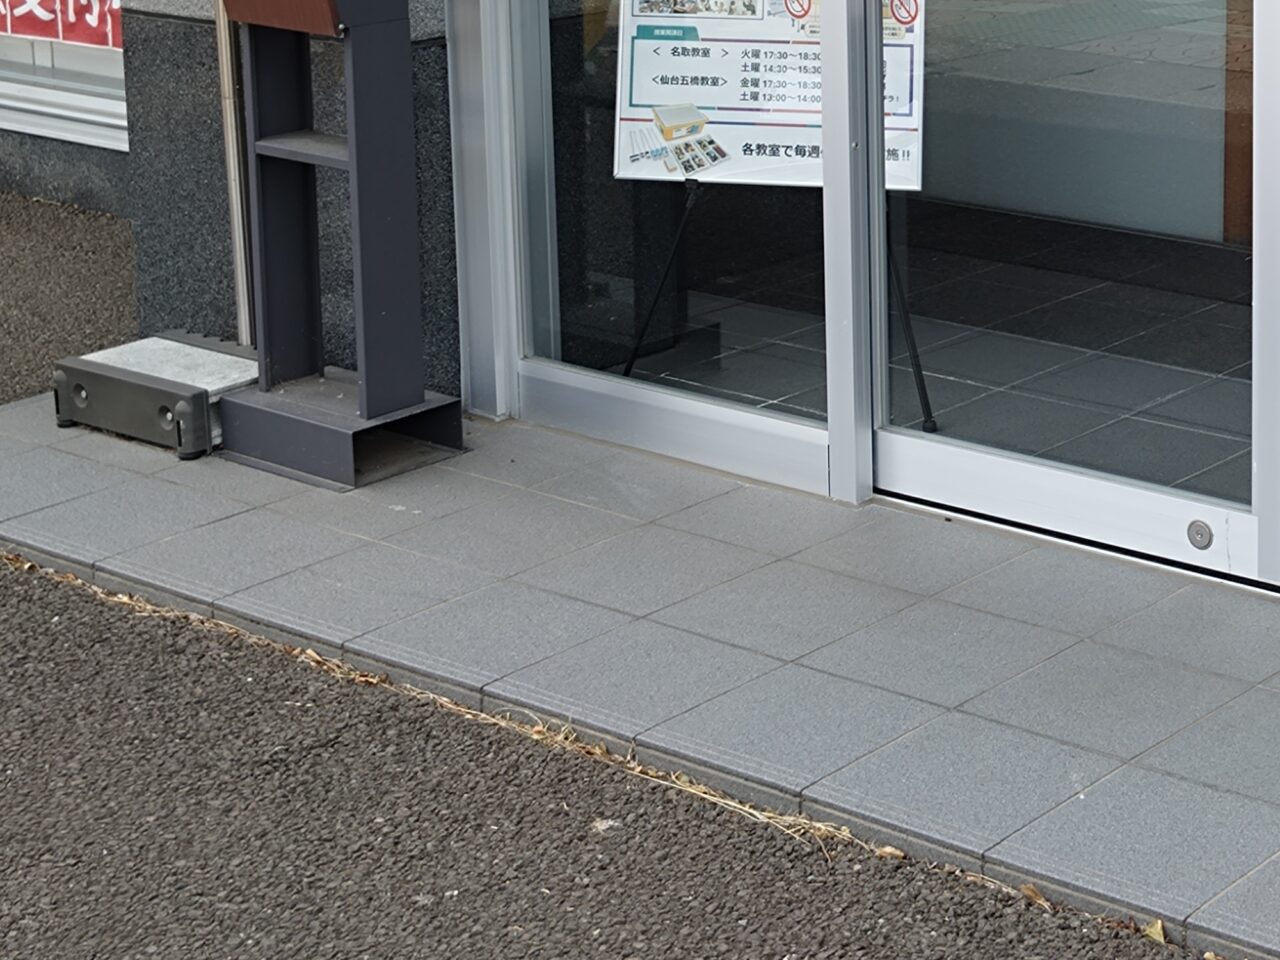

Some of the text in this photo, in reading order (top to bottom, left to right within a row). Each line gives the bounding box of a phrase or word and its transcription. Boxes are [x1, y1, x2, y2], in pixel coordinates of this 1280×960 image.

[671, 46, 711, 58] 名取教室
[741, 49, 760, 60] 火曜
[741, 63, 760, 73] 土曜
[740, 78, 760, 88] 金曜
[739, 92, 760, 102] 土曜
[742, 143, 823, 158] 各教室で毎週
